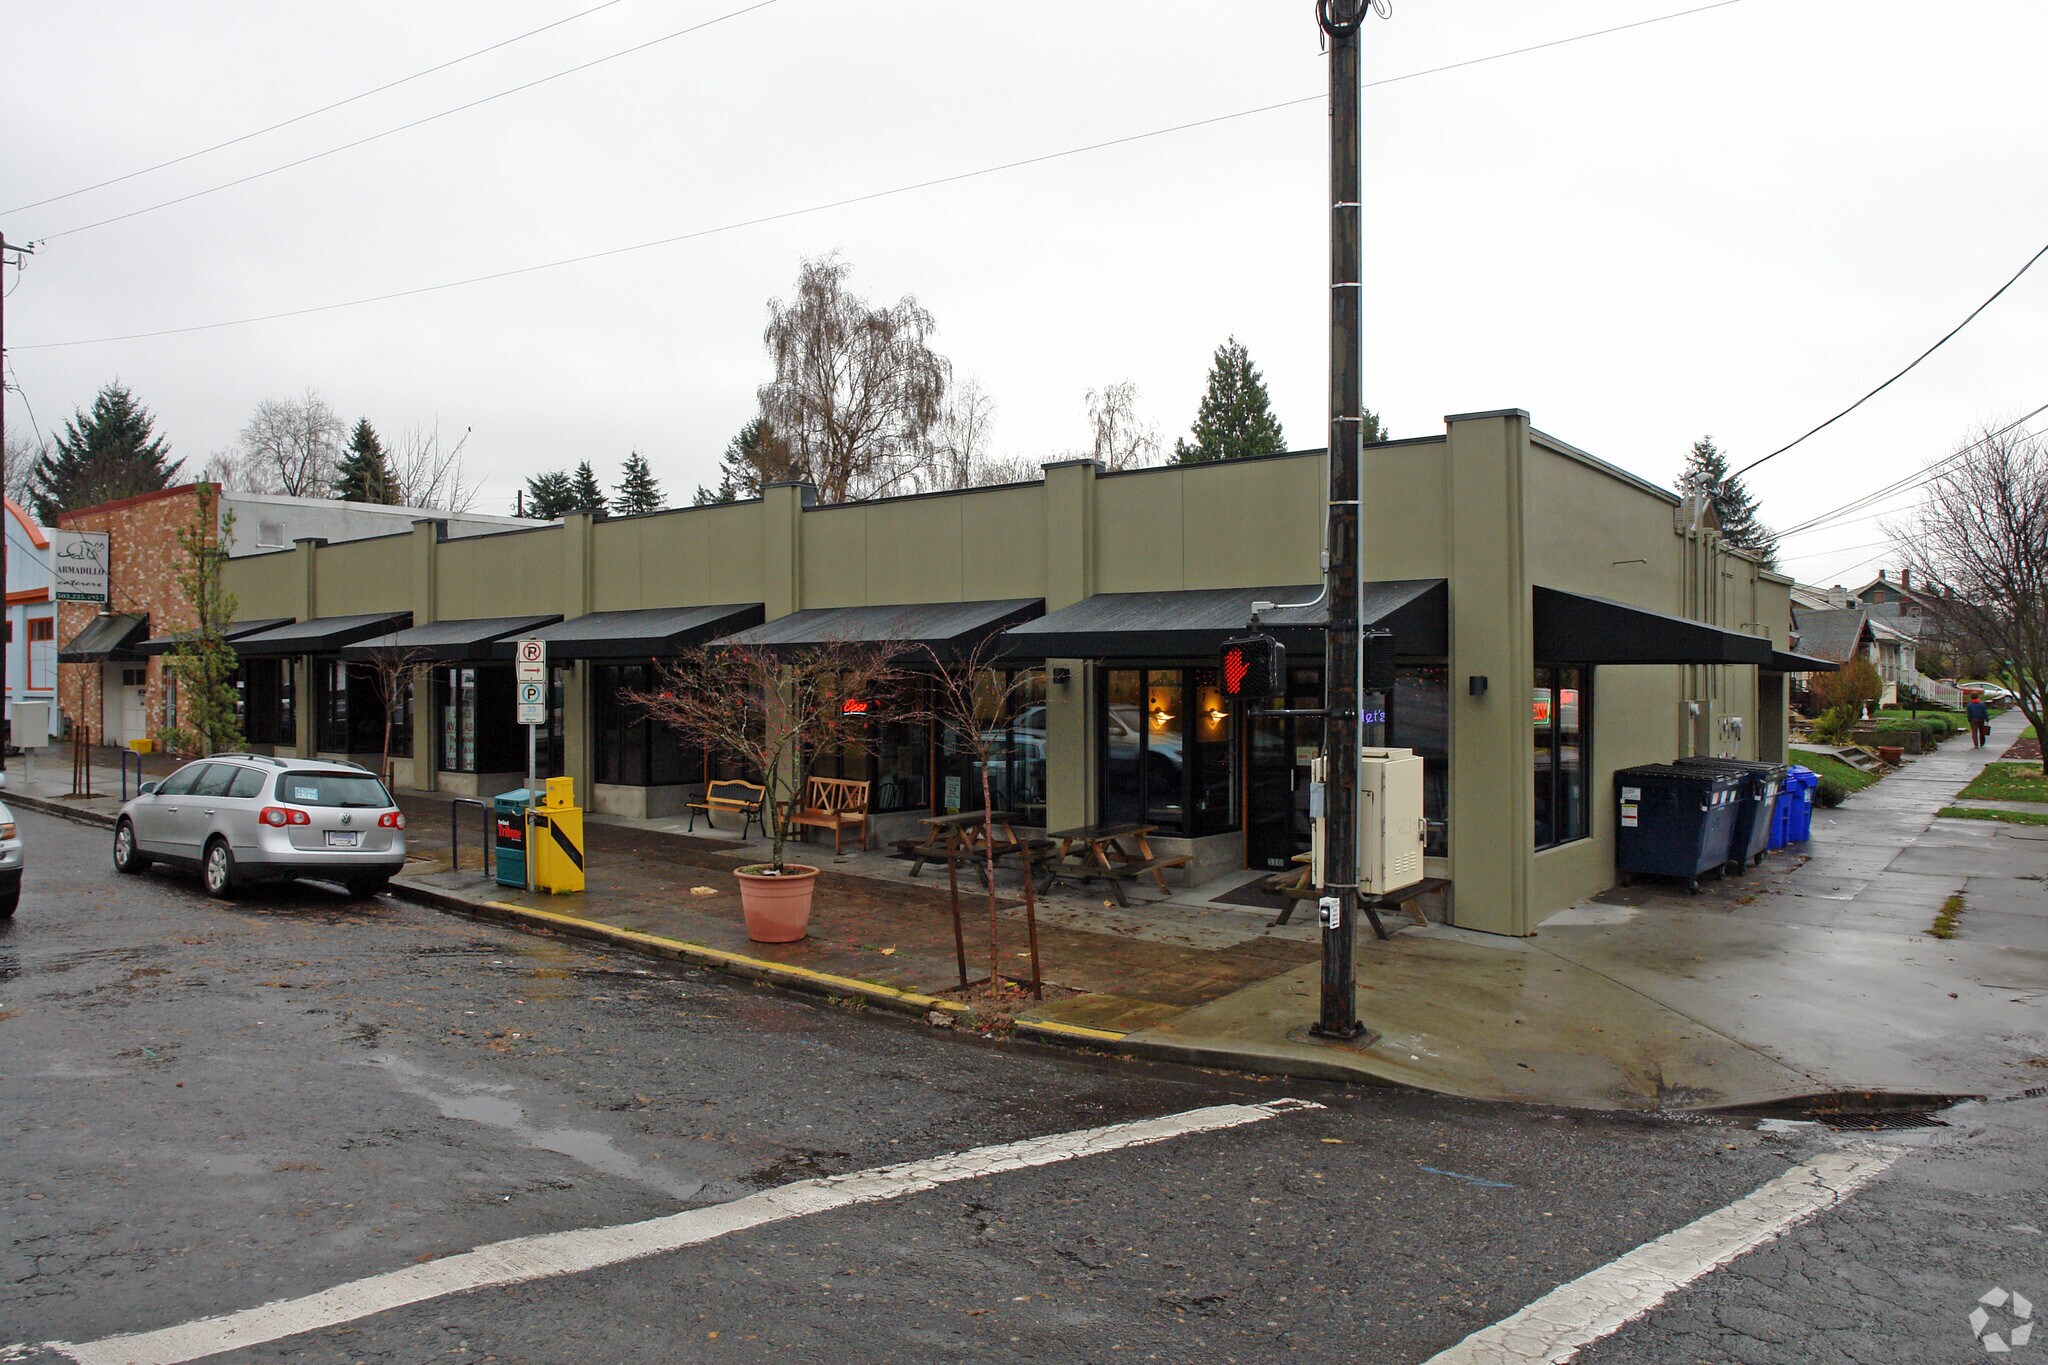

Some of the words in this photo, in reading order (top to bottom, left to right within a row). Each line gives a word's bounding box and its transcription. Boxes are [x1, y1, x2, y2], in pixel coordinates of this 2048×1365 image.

[58, 566, 105, 575] ARMADILLO
[527, 688, 536, 699] P
[498, 824, 521, 839] Tribune
